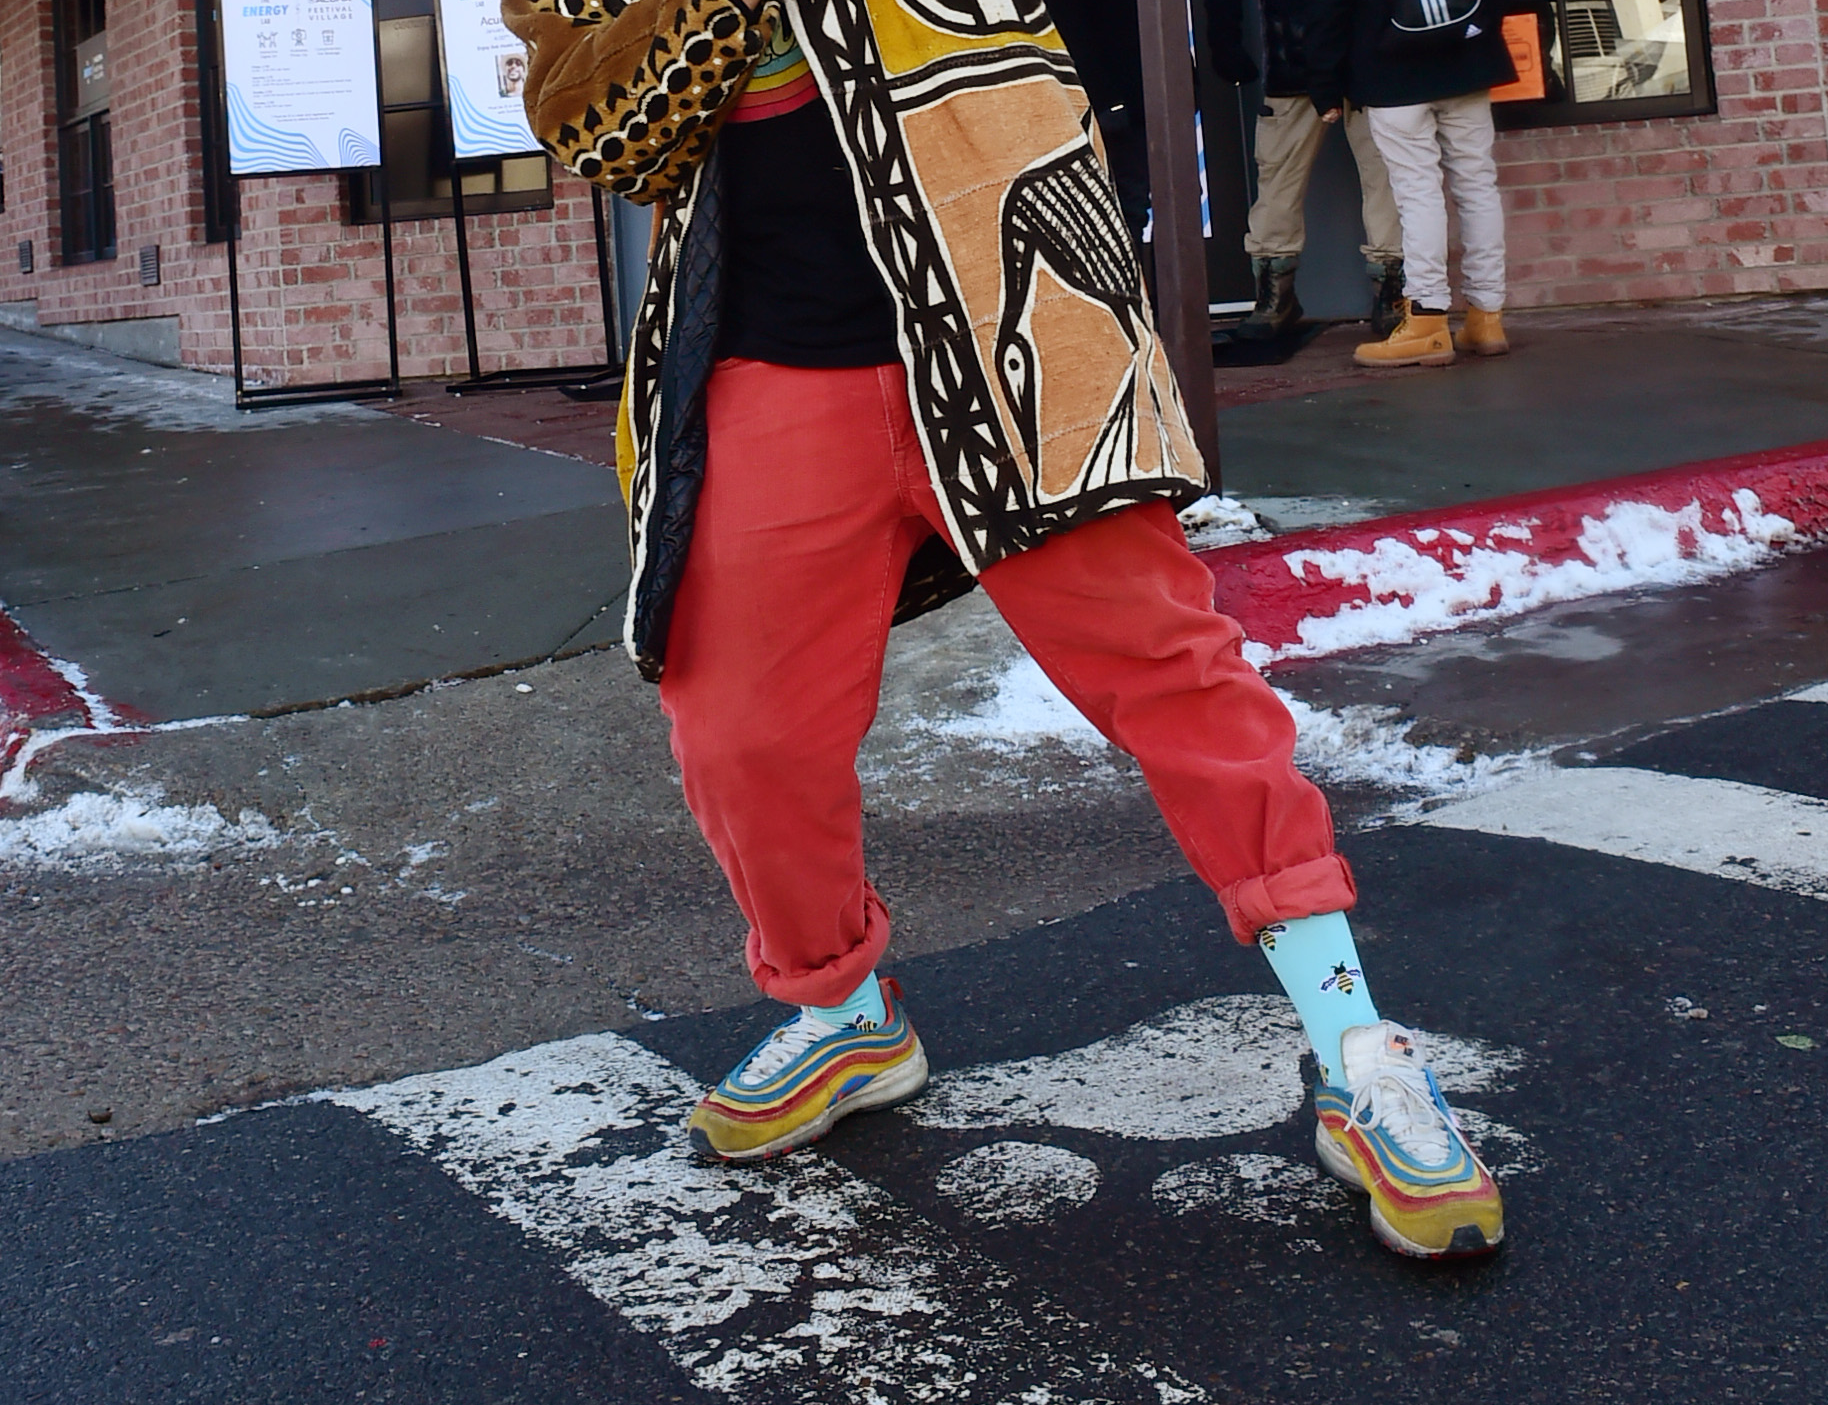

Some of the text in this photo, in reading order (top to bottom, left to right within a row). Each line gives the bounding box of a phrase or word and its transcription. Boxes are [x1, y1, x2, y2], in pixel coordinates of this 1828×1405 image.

[242, 4, 289, 17] ENERGY
[307, 6, 353, 14] FESTIVAL
[308, 13, 353, 22] VILLAGE
